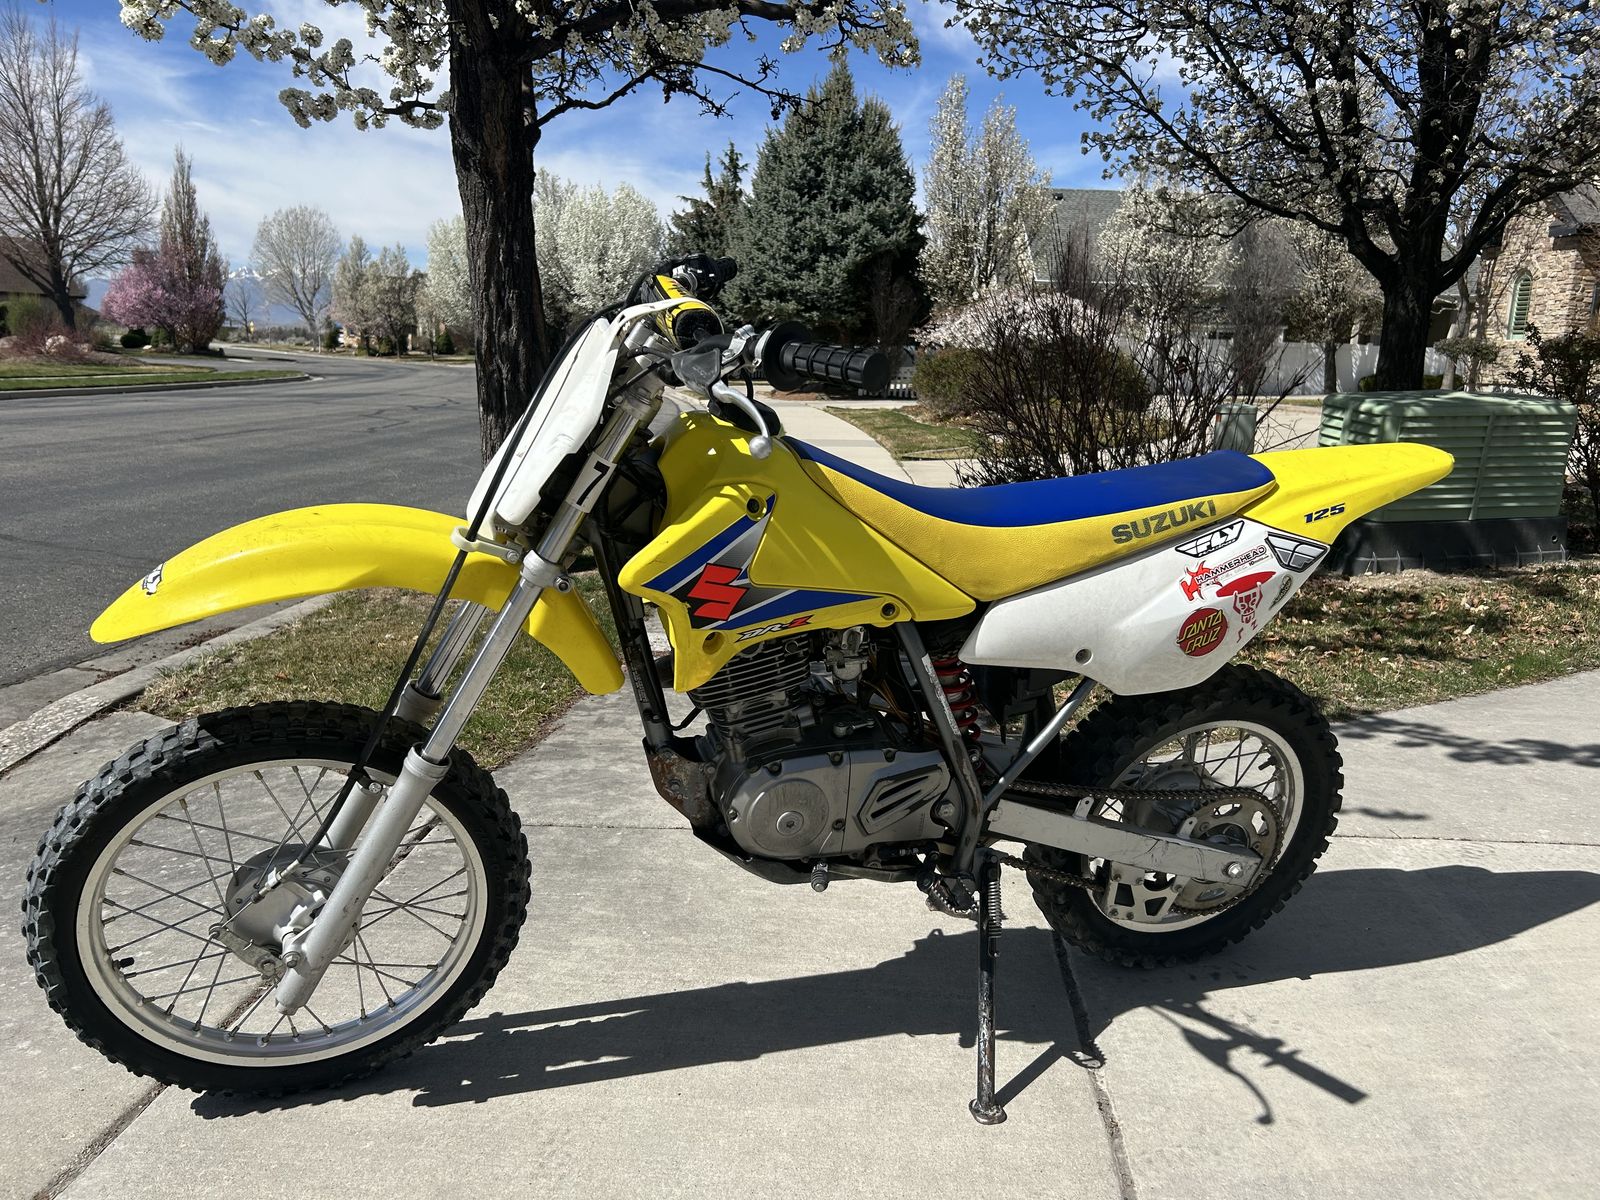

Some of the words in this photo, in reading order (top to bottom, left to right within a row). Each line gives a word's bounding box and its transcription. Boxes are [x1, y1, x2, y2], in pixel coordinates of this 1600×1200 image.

[576, 460, 610, 505] 7
[1111, 499, 1217, 545] SUZUKI
[1303, 502, 1346, 524] 125
[1185, 520, 1245, 557] FLY
[1195, 545, 1267, 585] HAMMERHEAD
[734, 614, 816, 643] DR-Z
[1176, 609, 1224, 644] SANTA
[1185, 626, 1222, 655] CRUZ
